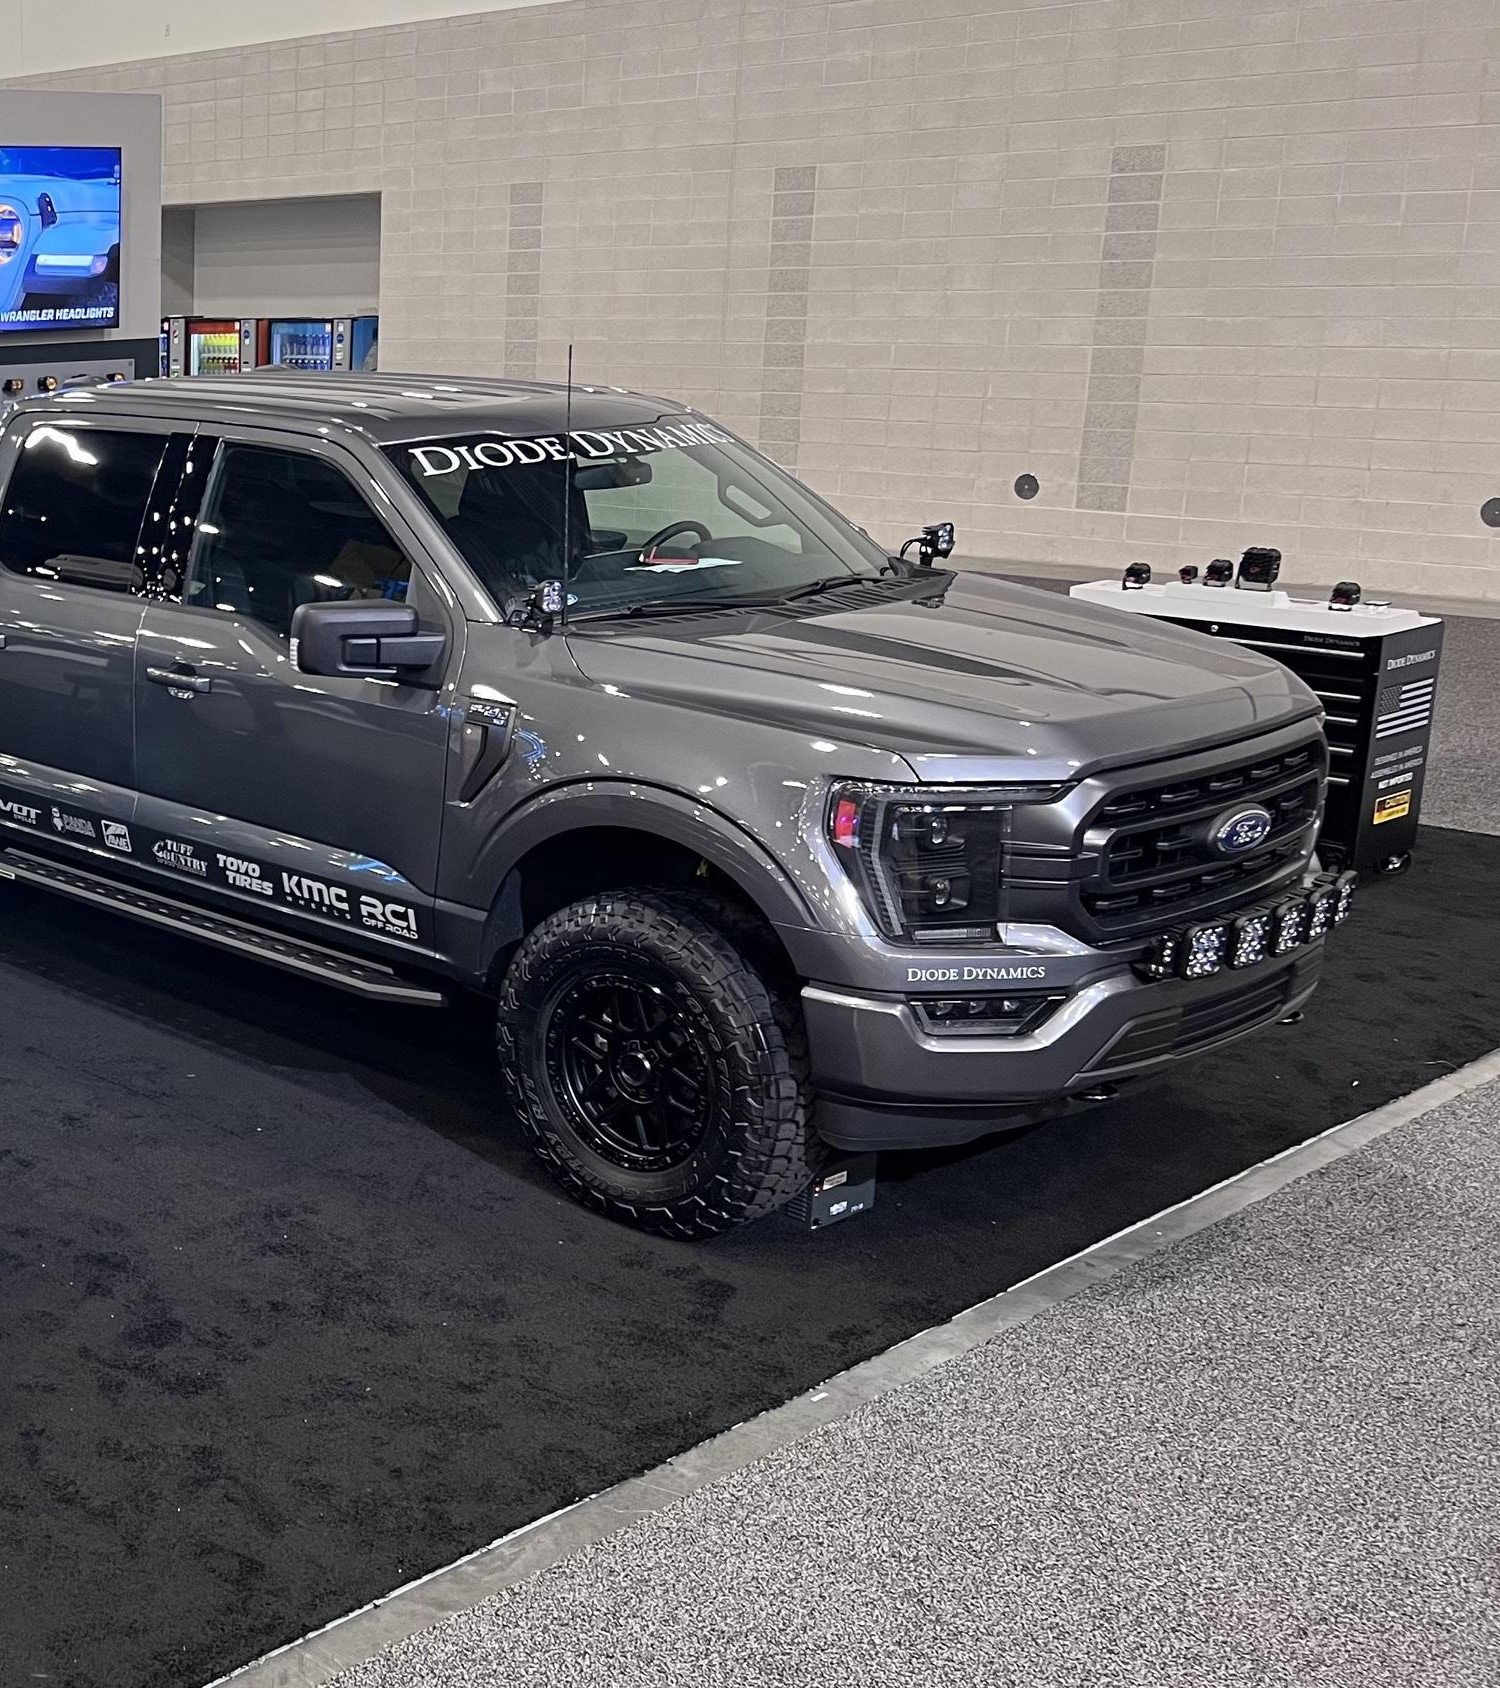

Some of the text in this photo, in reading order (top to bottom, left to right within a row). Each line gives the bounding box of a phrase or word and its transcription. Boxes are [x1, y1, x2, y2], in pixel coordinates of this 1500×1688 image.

[0, 306, 115, 322] WRANGLER HEADLIGHTS
[408, 422, 736, 477] DIODE DYNAMICS
[151, 840, 208, 872] COUNTRY
[165, 839, 194, 856] TUFF
[216, 853, 261, 877] TOYO
[226, 870, 273, 896] TIRES
[282, 872, 350, 911] KMC
[359, 894, 418, 932] RCI
[362, 917, 419, 940] OFF ROAD
[907, 966, 1046, 982] DIODE DYNAMICS
